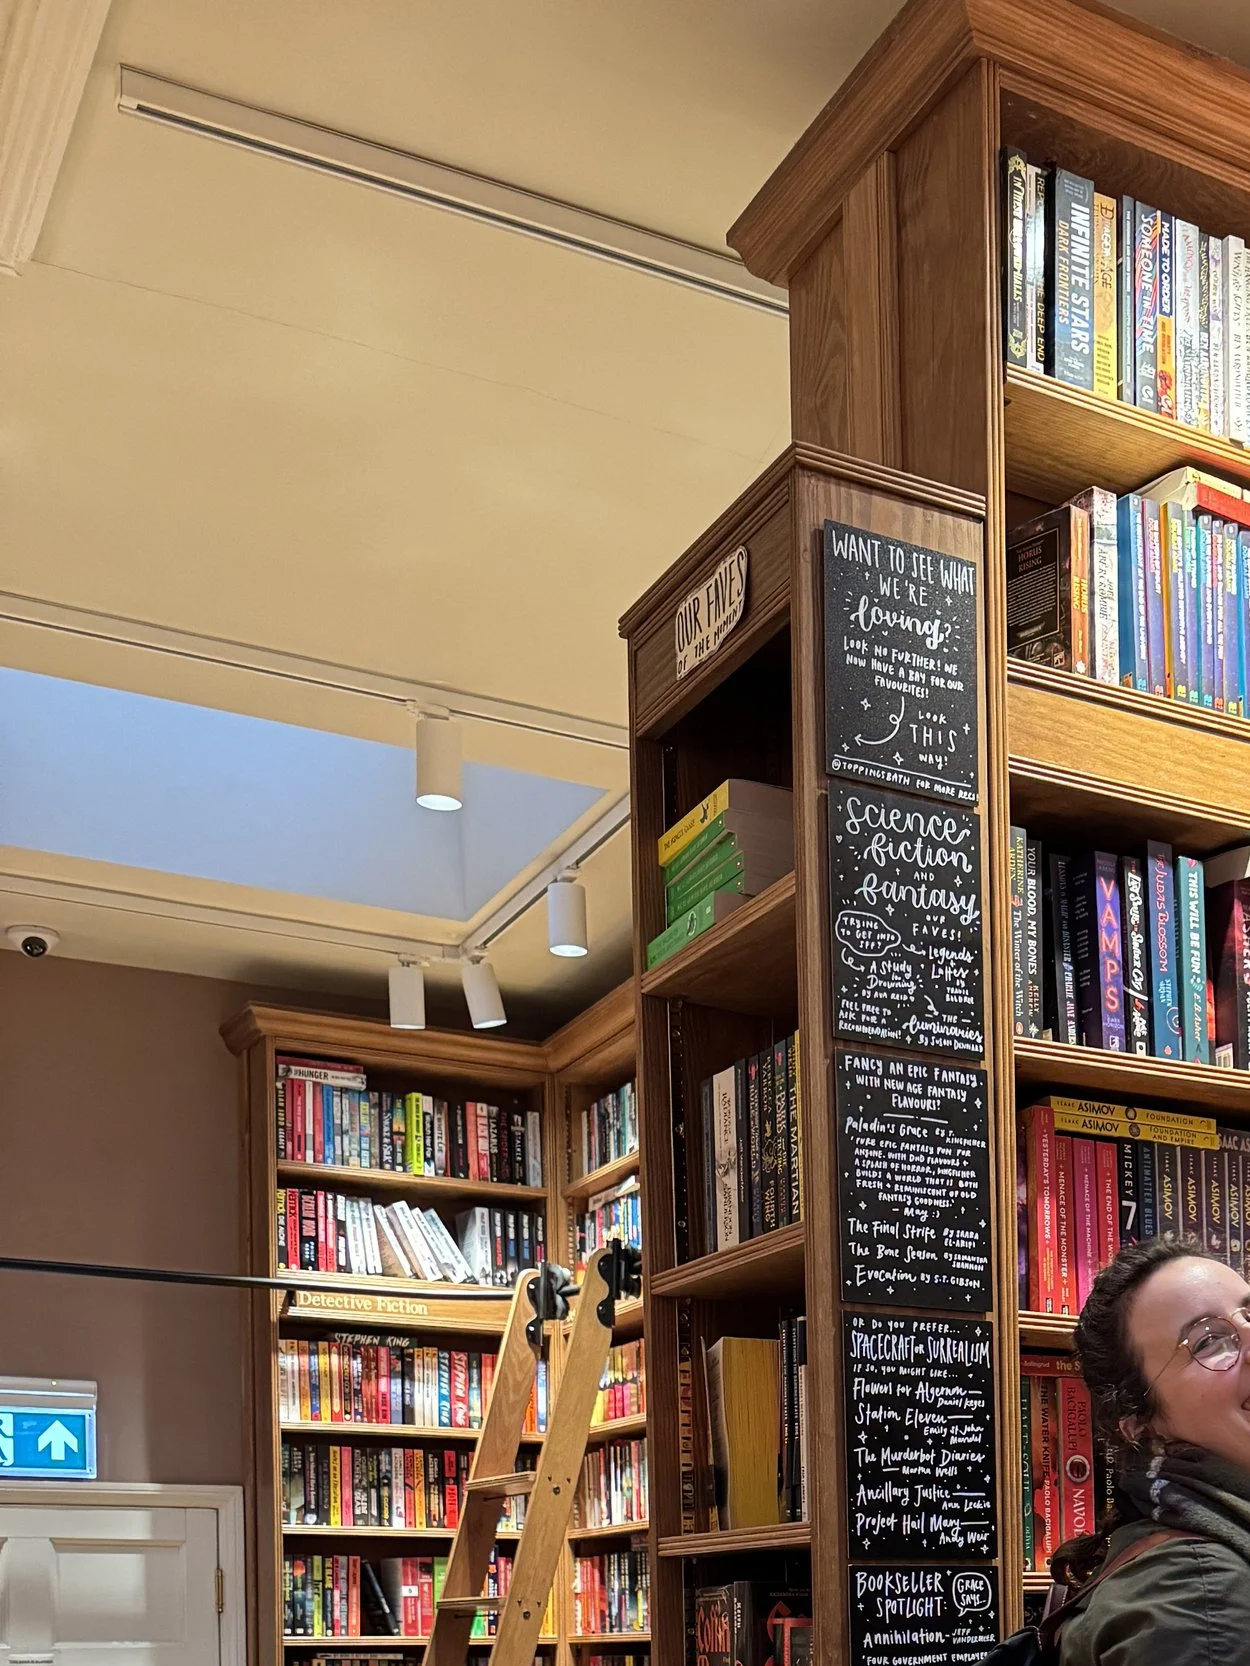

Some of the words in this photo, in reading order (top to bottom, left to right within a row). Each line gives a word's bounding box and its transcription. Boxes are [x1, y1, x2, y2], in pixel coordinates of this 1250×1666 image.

[1070, 202, 1091, 282] INFINITE
[1070, 287, 1090, 356] STARS
[832, 530, 881, 568] WANT
[889, 539, 904, 575] TO
[912, 552, 935, 584] SEE
[940, 561, 975, 596] WHAT
[677, 596, 702, 653] OUR
[706, 551, 745, 628] FAVES
[879, 574, 928, 607] WE'RE
[677, 655, 687, 674] OF
[694, 634, 710, 658] THE
[714, 601, 743, 646] MOMENT
[844, 636, 868, 652] LOOK
[874, 645, 887, 657] NO
[892, 649, 942, 671] FURTHER!
[945, 663, 958, 675] WE
[846, 654, 866, 668] NOW
[872, 658, 894, 675] HAVE
[899, 665, 905, 678] A
[909, 670, 926, 684] BAY
[930, 675, 947, 688] FOR
[947, 679, 964, 691] OUR
[874, 675, 929, 699] FAVOURITES!
[918, 710, 947, 724] LOOK
[909, 724, 957, 752] THIS
[918, 753, 948, 770] WAY!
[845, 797, 970, 845] Science
[913, 870, 935, 881] AND
[912, 923, 962, 941] FAVES!
[928, 946, 974, 965] Legends
[879, 961, 912, 980] Study
[844, 1055, 883, 1075] FANCY
[889, 1061, 903, 1075] AN
[907, 1064, 928, 1078] EPIC
[934, 1067, 977, 1087] FANTASY
[856, 1075, 880, 1089] WITH
[884, 1079, 904, 1092] NEW
[907, 1081, 922, 1094] AGE
[928, 1086, 966, 1102] FANTASY
[1077, 1101, 1116, 1117] ASIMOV
[1145, 1112, 1194, 1126] FOUNDATION
[845, 1116, 895, 1134] Paladin's
[900, 1123, 928, 1138] Grace
[1123, 1142, 1132, 1198] MICKEY
[1121, 1200, 1137, 1231] 7
[848, 1218, 869, 1236] The
[872, 1220, 900, 1240] Final
[299, 1291, 372, 1310] Detective
[377, 1297, 428, 1315] Fiction
[888, 1319, 904, 1330] YOU
[334, 1331, 381, 1347] STEPHEN
[850, 1330, 916, 1361] SPACECRAFT
[927, 1336, 990, 1368] SURREALISM
[881, 1366, 896, 1375] YOU
[899, 1367, 926, 1376] MIGHT
[915, 1381, 967, 1404] Algernon
[855, 1403, 901, 1426] Station
[905, 1408, 947, 1428] Eleven
[854, 1447, 876, 1467] The
[881, 1447, 937, 1466] Murderbot
[940, 1449, 985, 1467] Diaries
[856, 1512, 898, 1536] Project
[902, 1512, 925, 1535] Hail
[930, 1514, 962, 1534] Mary
[856, 1571, 944, 1599] BOOKSELLER
[957, 1578, 985, 1593] GRACE
[876, 1596, 948, 1623] SPOTLIGHT:
[892, 1653, 948, 1665] GOVERNMENT
